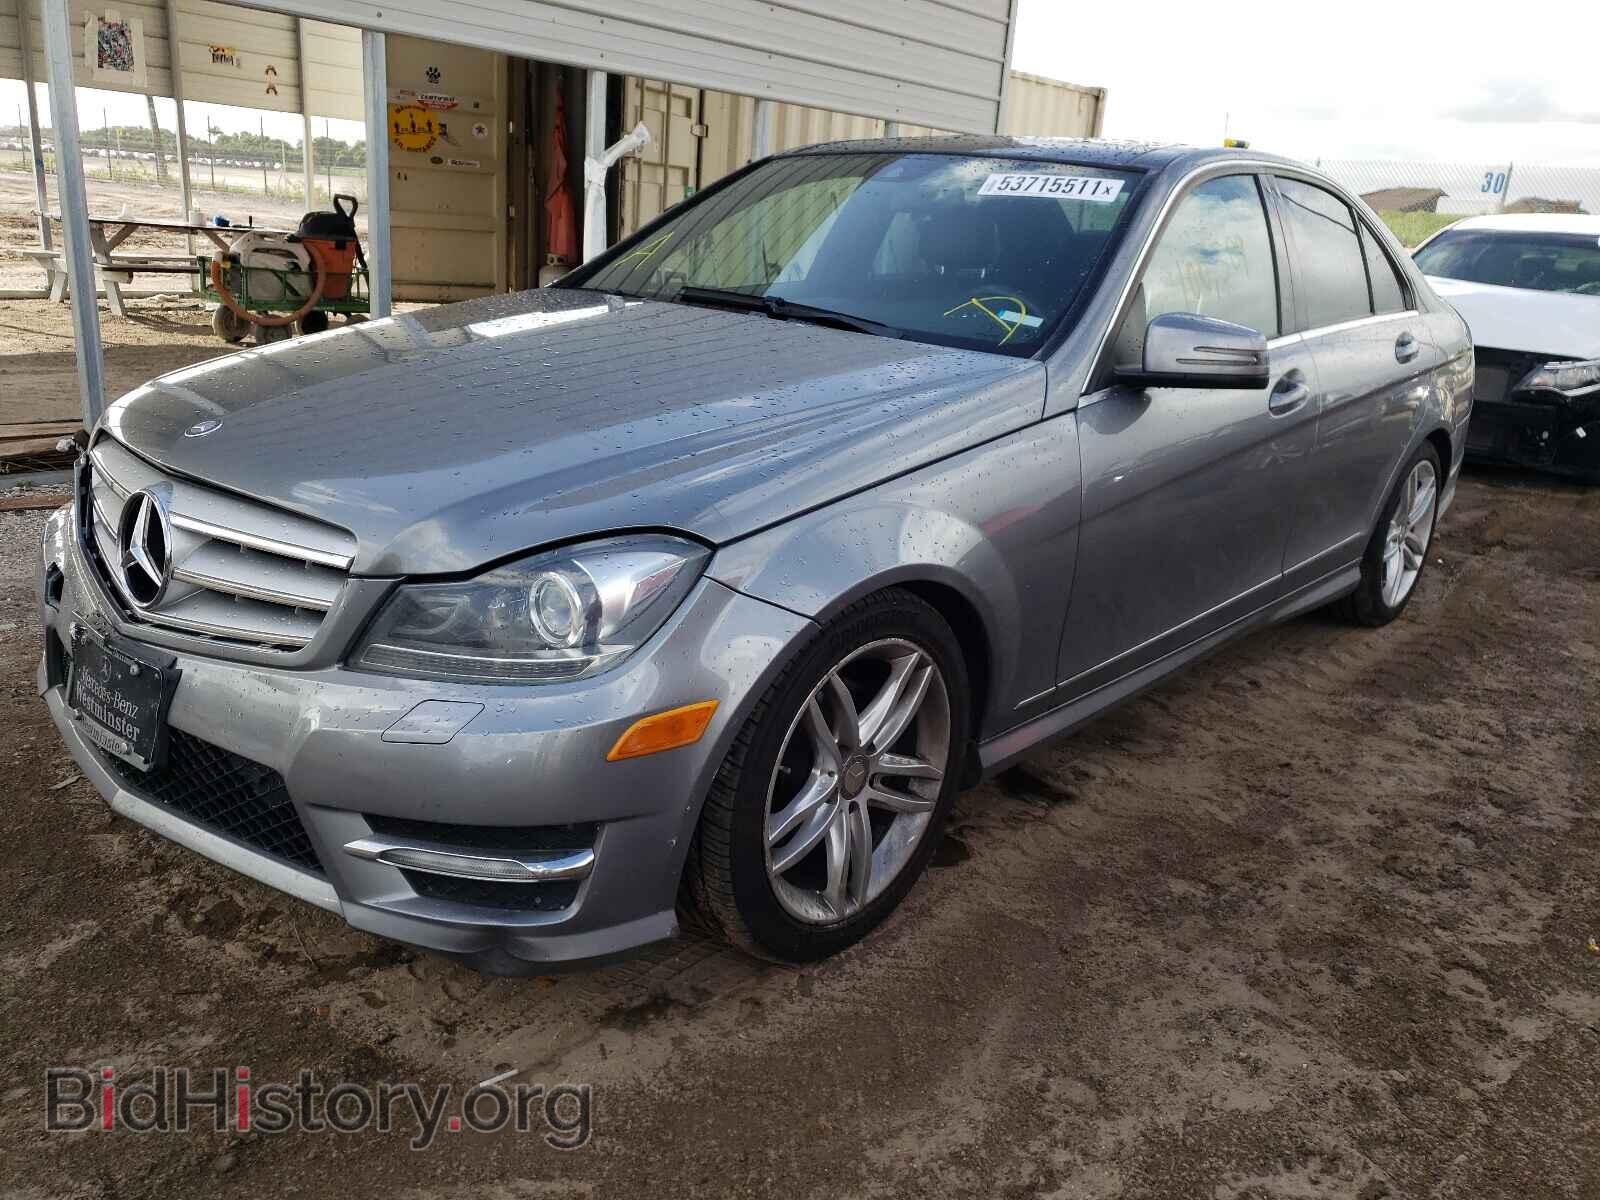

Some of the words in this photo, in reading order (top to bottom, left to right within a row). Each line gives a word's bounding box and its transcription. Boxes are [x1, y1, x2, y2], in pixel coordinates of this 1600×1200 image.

[1481, 172, 1505, 194] 30
[76, 681, 140, 742] Westminster
[80, 667, 140, 719] Mercedes-Benz
